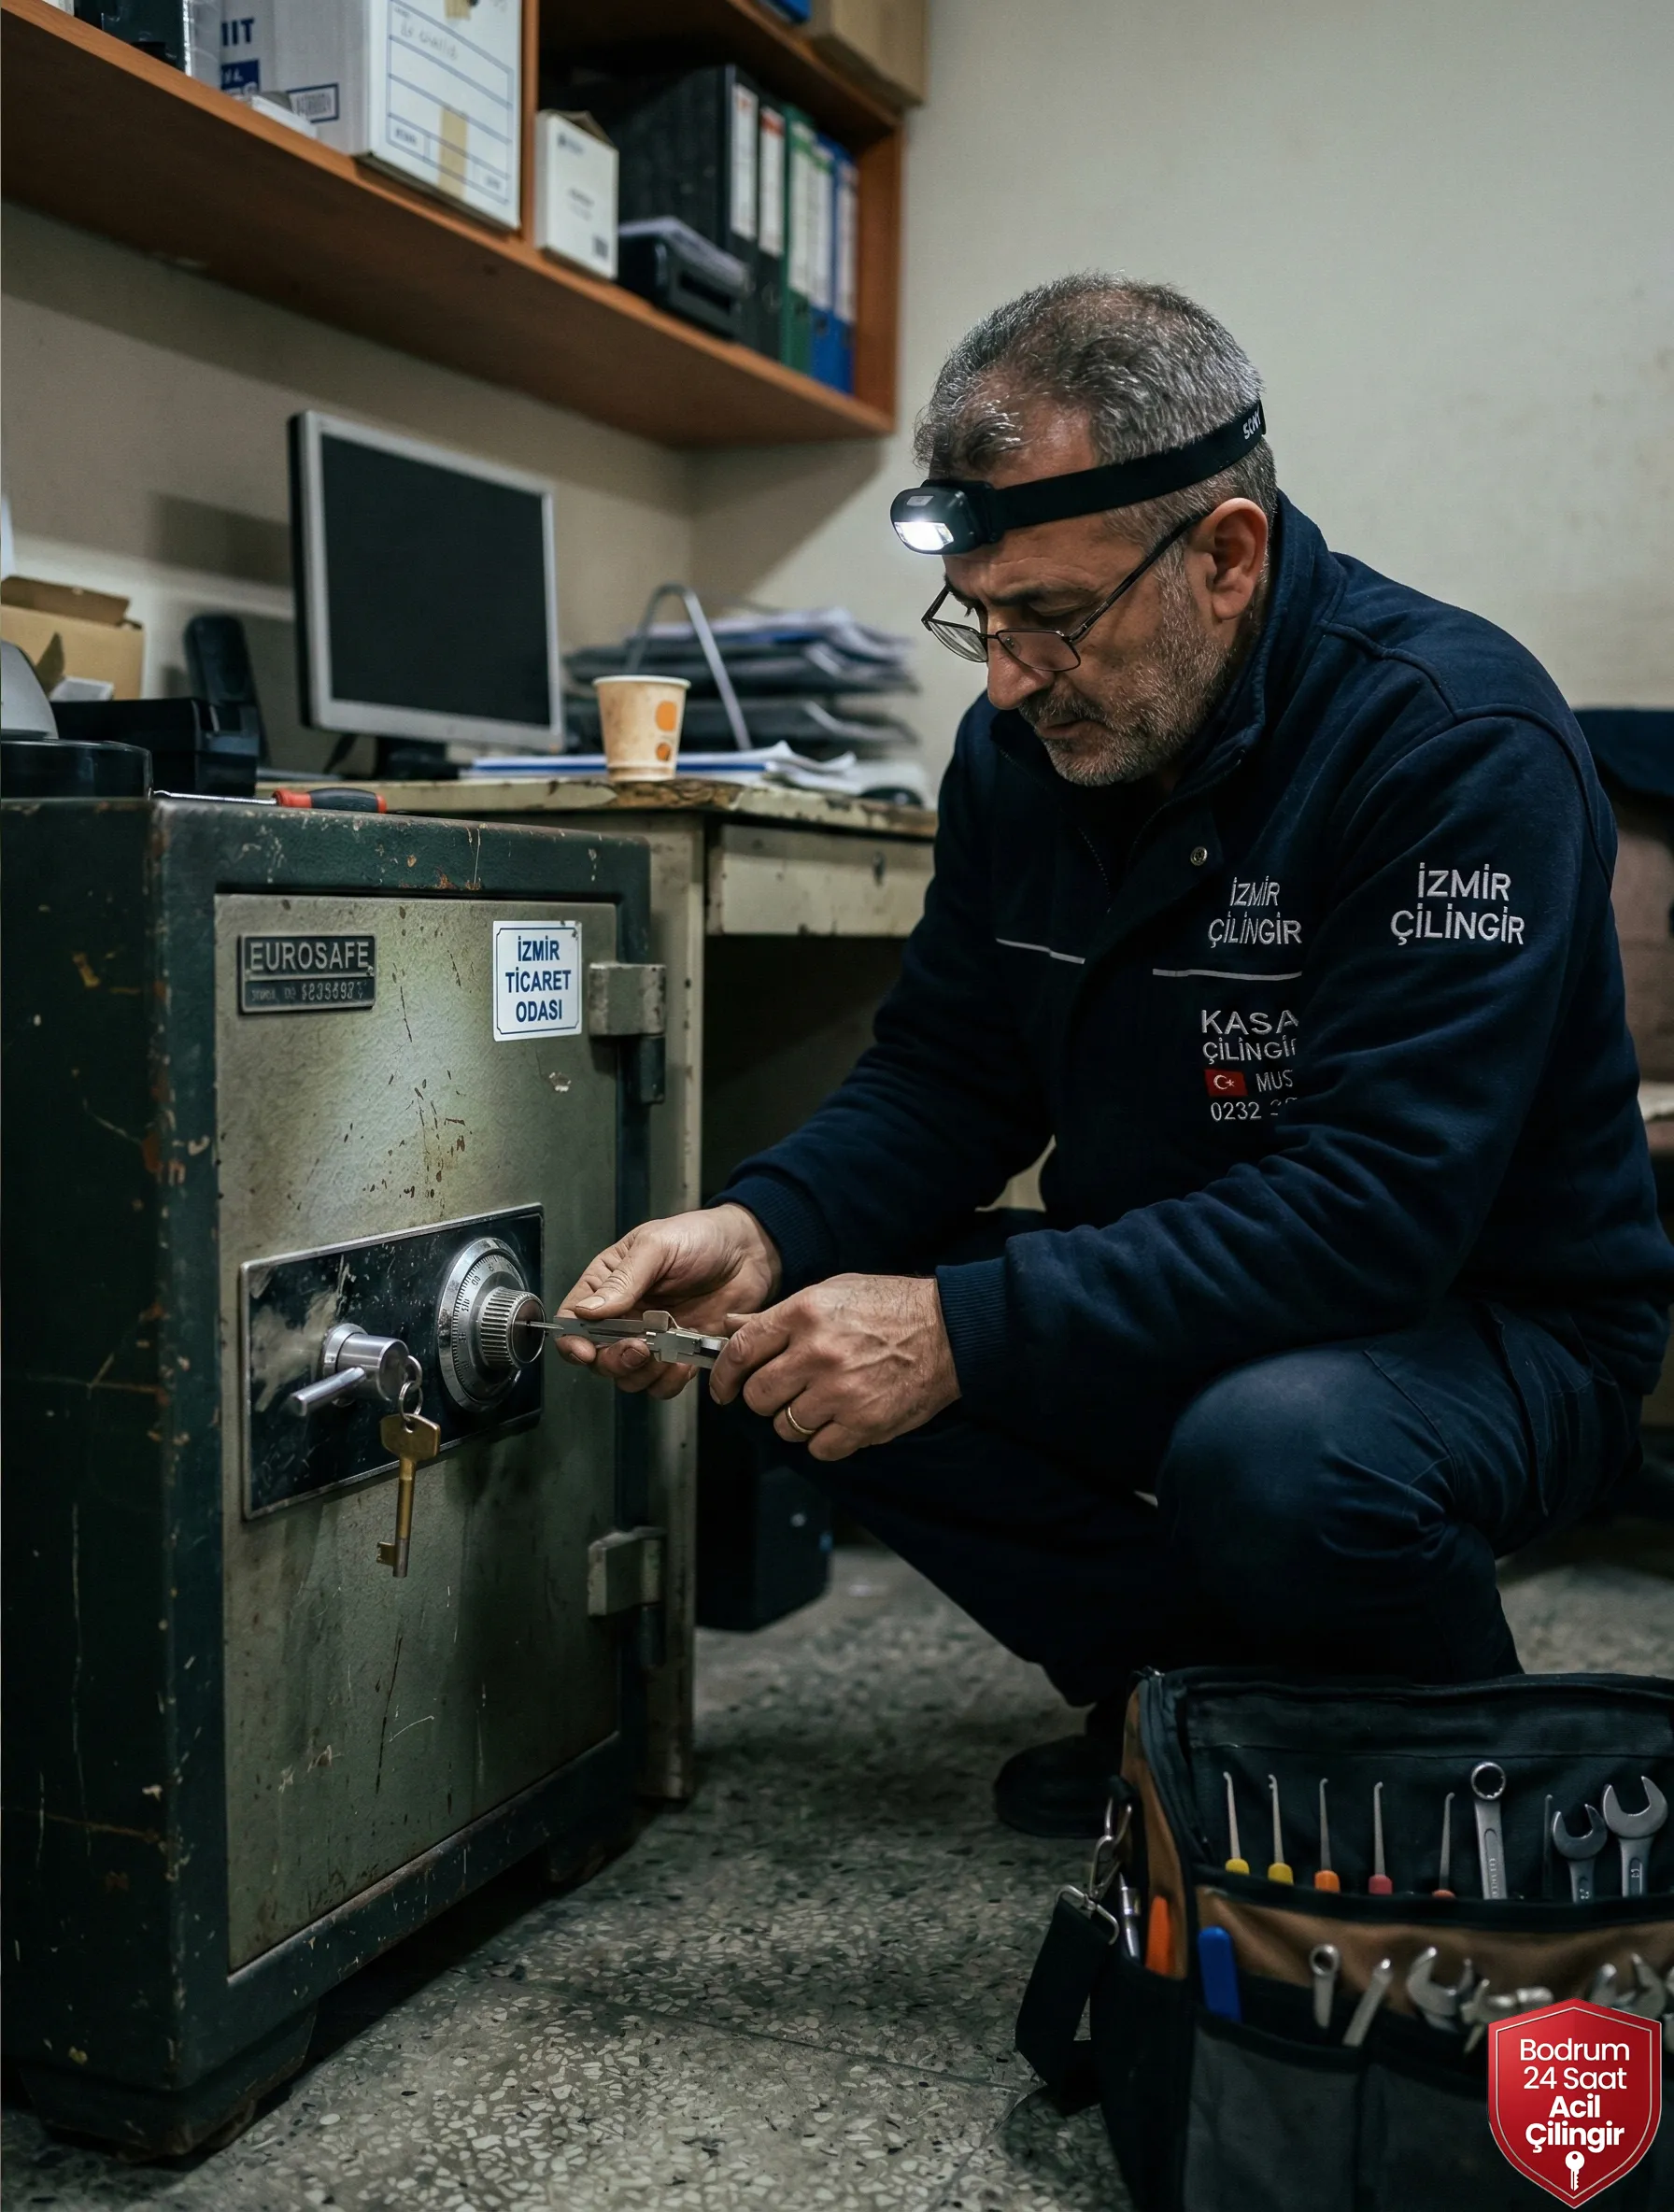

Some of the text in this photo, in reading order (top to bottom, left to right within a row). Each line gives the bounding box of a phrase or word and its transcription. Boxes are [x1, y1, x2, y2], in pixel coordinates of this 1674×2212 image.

[1229, 875, 1281, 906] İZMİR
[1418, 862, 1511, 901] İZMİR
[1208, 911, 1302, 948] ÇİLİNGİR
[1390, 902, 1525, 946] ÇİLİNGİR
[250, 941, 370, 971] EUROSAFE
[518, 935, 560, 961] İZMİR
[505, 966, 572, 993] TİCARET
[516, 999, 562, 1023] ODASI
[1201, 1009, 1299, 1035] KASA
[1256, 1069, 1294, 1092] MUS
[1210, 1101, 1262, 1121] 0232
